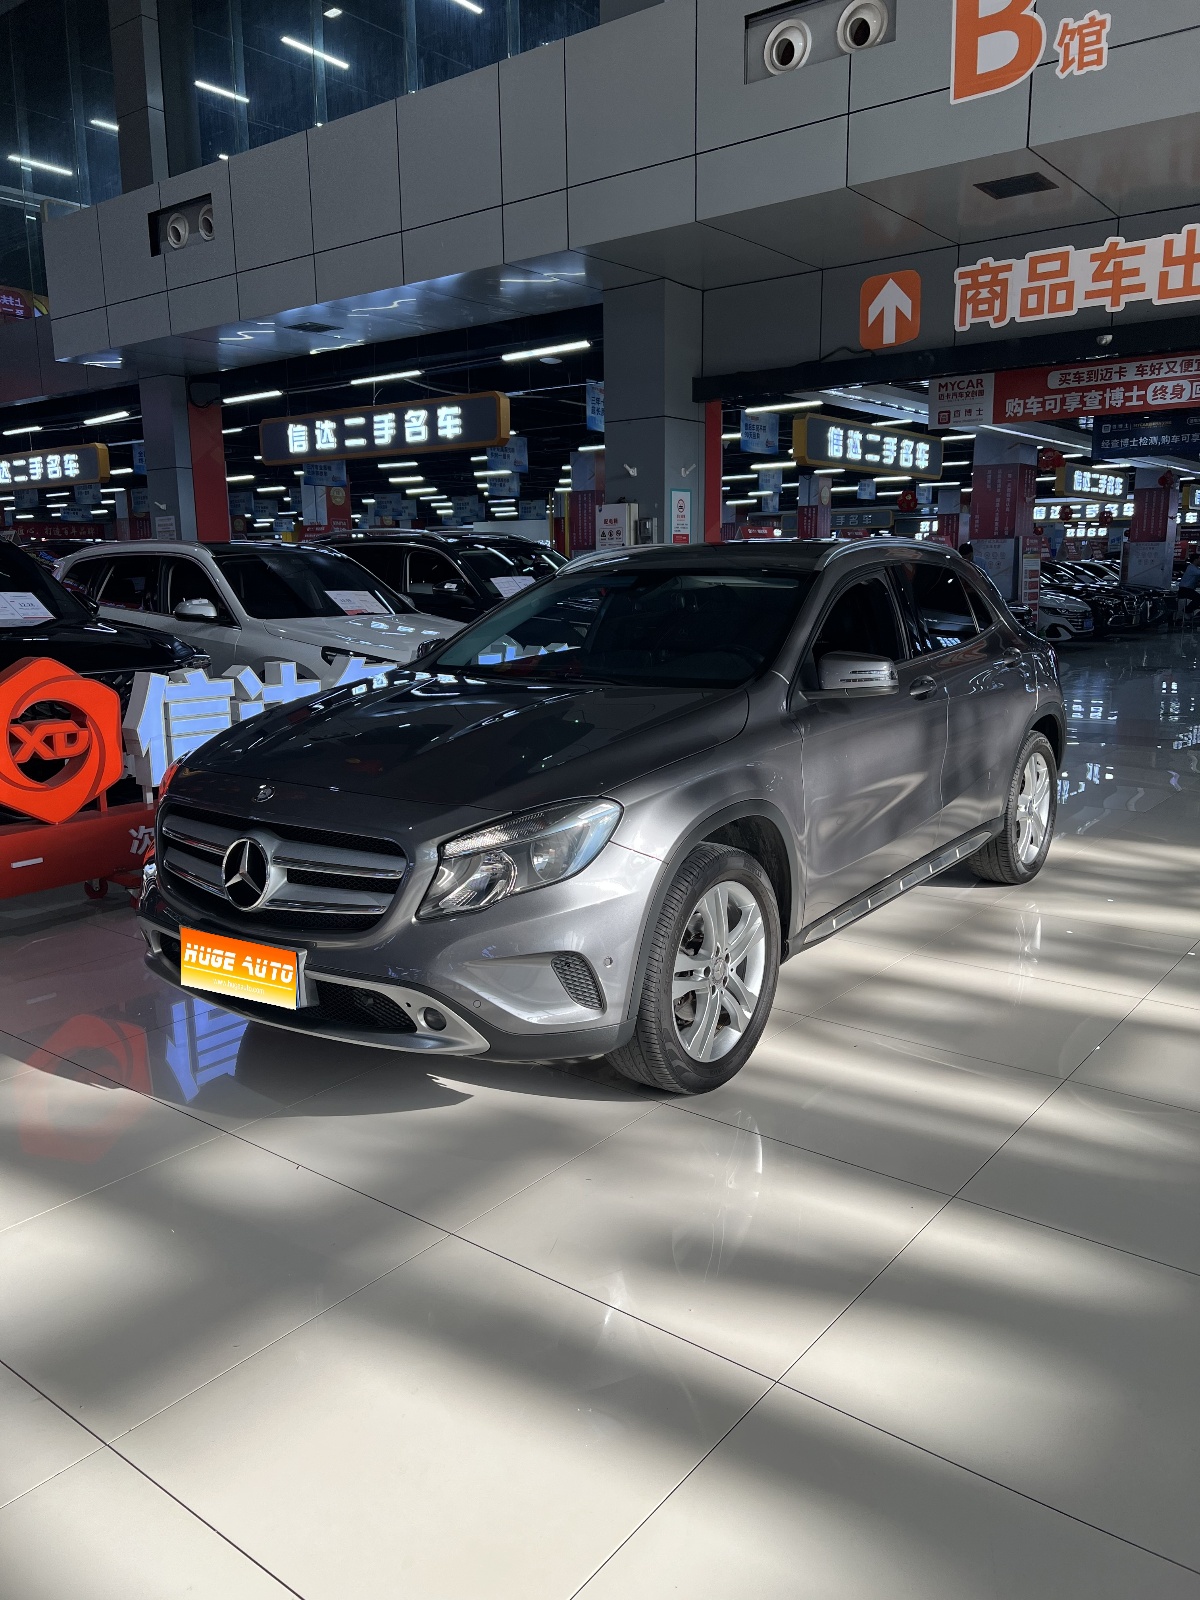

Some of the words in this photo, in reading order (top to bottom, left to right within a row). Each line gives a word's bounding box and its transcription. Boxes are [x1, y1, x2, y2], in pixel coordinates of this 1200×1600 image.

[938, 378, 984, 393] MYCAR
[1058, 366, 1127, 387] 买车到迈卡
[287, 405, 463, 454] 信达二手名车
[828, 425, 930, 469] 信达二手名车
[8, 721, 90, 763] XD
